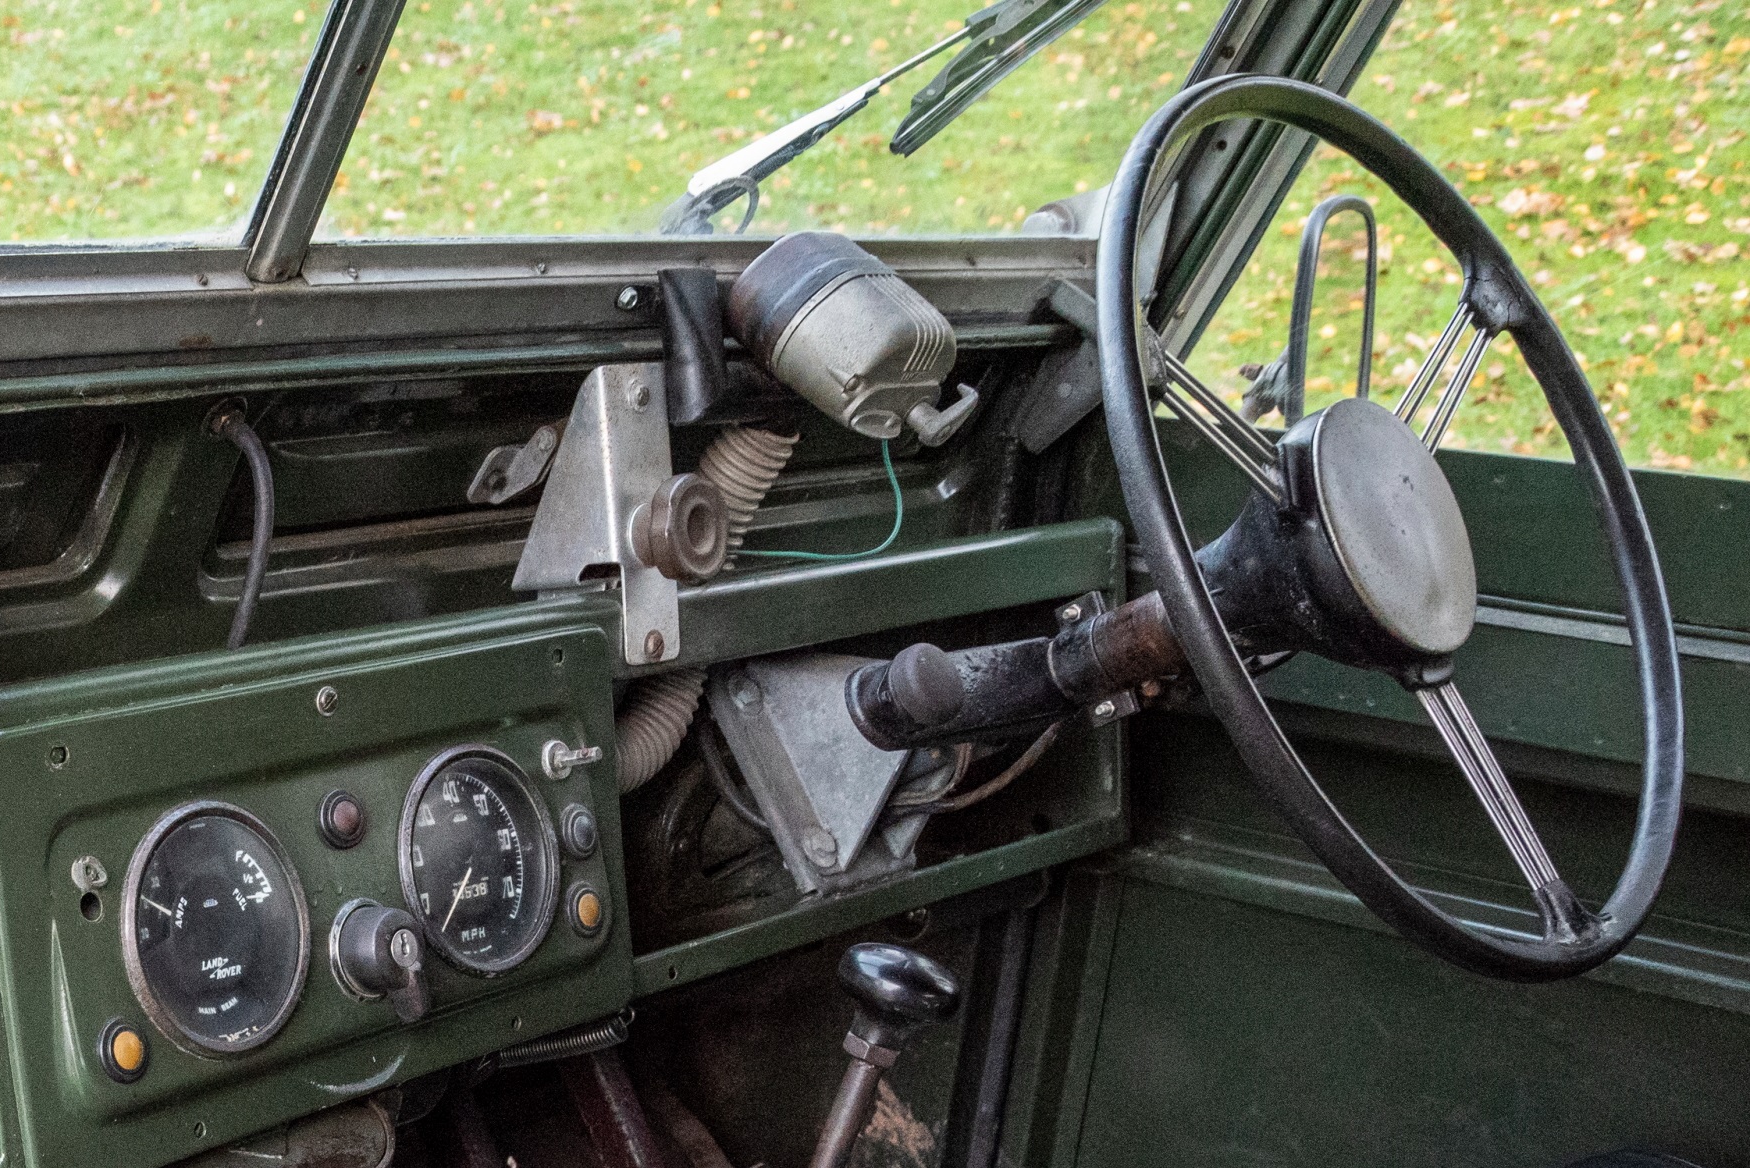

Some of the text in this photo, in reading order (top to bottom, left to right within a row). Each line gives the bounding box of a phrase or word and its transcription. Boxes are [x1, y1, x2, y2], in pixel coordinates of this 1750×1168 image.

[442, 780, 460, 804] 40
[472, 793, 490, 817] 50
[235, 850, 244, 862] F
[231, 887, 249, 912] FUEL
[174, 896, 189, 930] AMPS
[201, 956, 224, 972] LAND
[216, 964, 243, 980] ROVER
[198, 996, 239, 1015] MAIN BEAM
